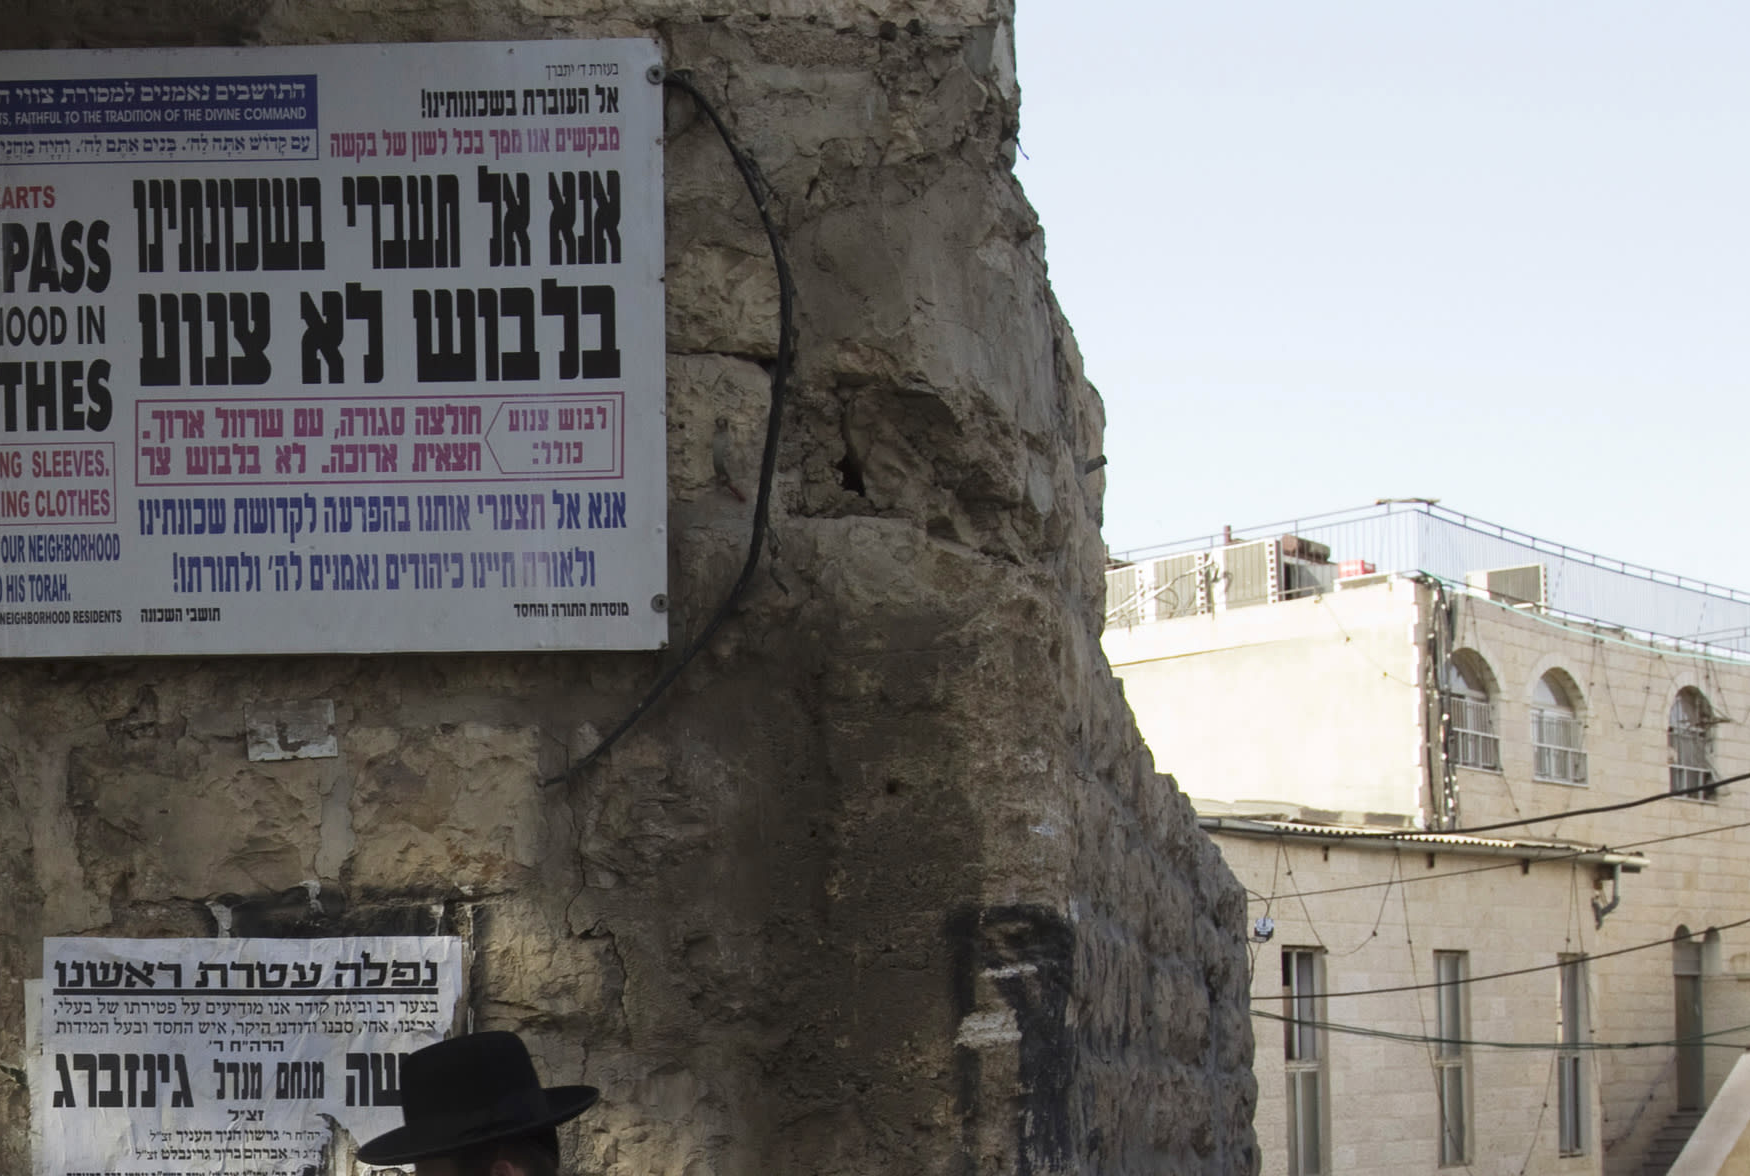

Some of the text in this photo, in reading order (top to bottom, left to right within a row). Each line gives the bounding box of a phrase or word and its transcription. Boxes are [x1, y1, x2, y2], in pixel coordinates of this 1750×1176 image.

[60, 81, 135, 103] למסורת
[140, 84, 210, 101] נאמנים
[215, 83, 306, 100] התושבים
[522, 88, 589, 115] העוברת
[595, 84, 619, 113] אל
[15, 111, 62, 125] FAITHFUL
[65, 110, 80, 124] TO
[82, 110, 101, 123] THE
[104, 109, 162, 123] TRADITION
[164, 109, 180, 121] OF
[183, 108, 204, 121] THE
[205, 108, 240, 120] DIVINE
[244, 107, 306, 121] COMMAND
[133, 165, 621, 272] אנא אל תעברי בשכונתינו
[2, 220, 111, 293] PASS
[77, 305, 106, 344] IN
[138, 278, 621, 386] בלבוש לא צנוע
[142, 404, 481, 443] חולצה סגורה, עם שרוול ארוך.
[508, 406, 607, 432] לבוש צנוע
[32, 449, 110, 478] SLEEVES.
[141, 442, 481, 476] חצאית ארוכה. לא בלבוש צר
[35, 488, 111, 517] CLOTHES
[138, 489, 627, 543] אנא אל תצערי אותנו בהפרעה לקדושת שכונתינו
[1, 535, 25, 563] OUR
[29, 533, 120, 562] NEIGHBORHOOD
[54, 950, 438, 988] נפלה עטרת ראשנו
[97, 998, 119, 1014] של
[124, 1001, 177, 1014] פטירתו
[182, 998, 200, 1014] על
[205, 1001, 263, 1014] מודיעים
[268, 1001, 290, 1014] אנו
[335, 1000, 372, 1016] וביגון
[377, 1001, 394, 1013] רב
[400, 1000, 439, 1013] בצער
[53, 1053, 324, 1108] מנחם מנדל גינזברג
